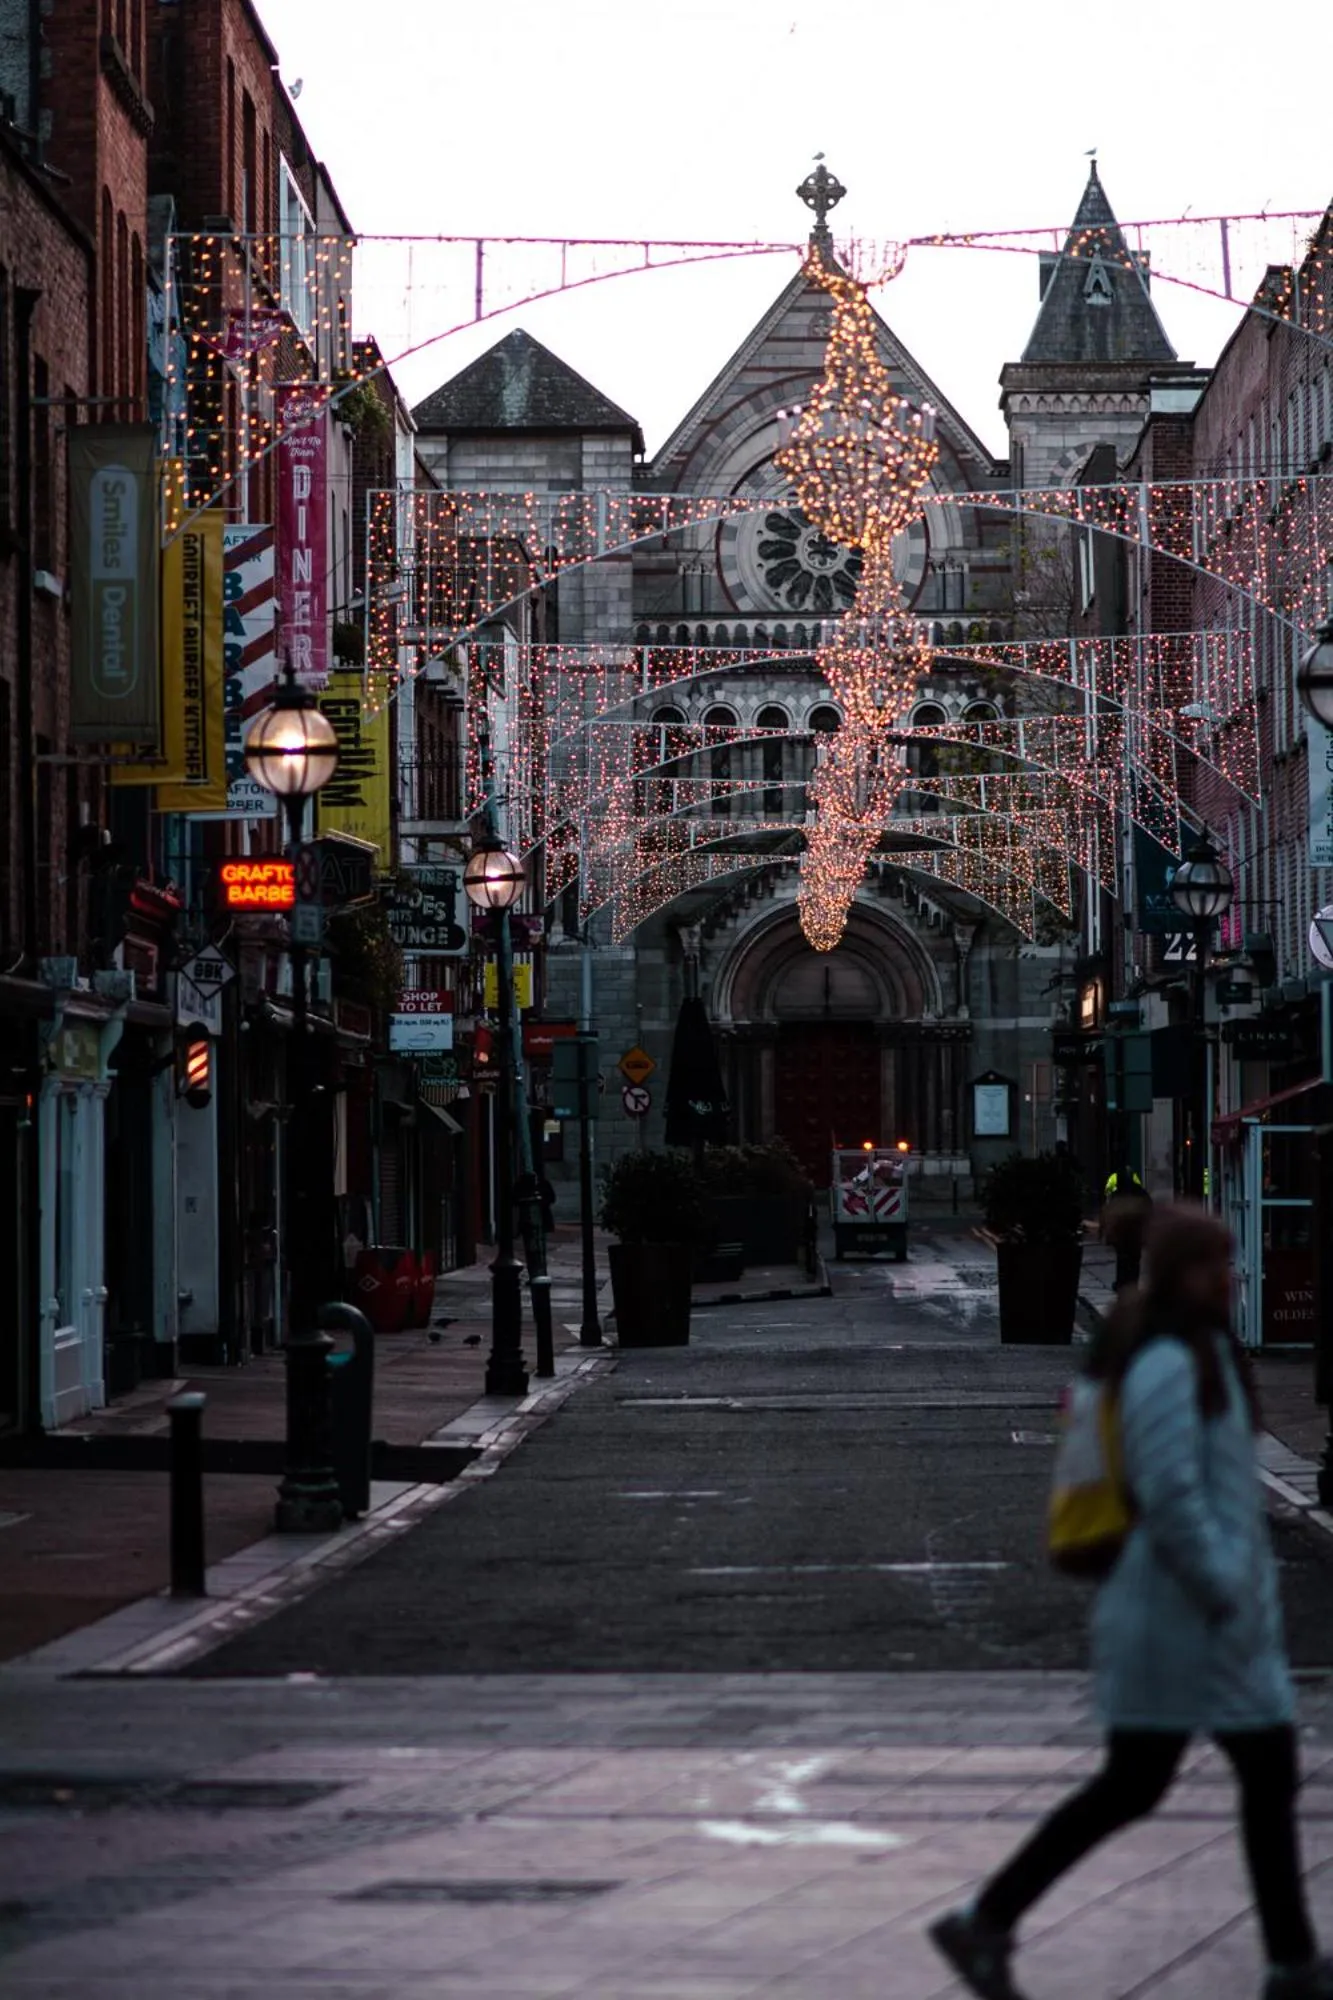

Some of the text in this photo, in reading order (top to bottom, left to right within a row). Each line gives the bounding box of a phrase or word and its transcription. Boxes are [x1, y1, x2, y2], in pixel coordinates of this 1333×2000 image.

[102, 480, 128, 679] Smiles Dental
[182, 532, 199, 620] GOURMET
[292, 464, 313, 670] DINER
[183, 626, 200, 700] BURGER
[223, 572, 246, 779] BARBER
[317, 698, 384, 807] GOTHAM
[228, 884, 295, 902] BARBE
[392, 925, 449, 945] UNGE
[398, 1002, 442, 1012] TO LET
[402, 991, 438, 1002] SHOP
